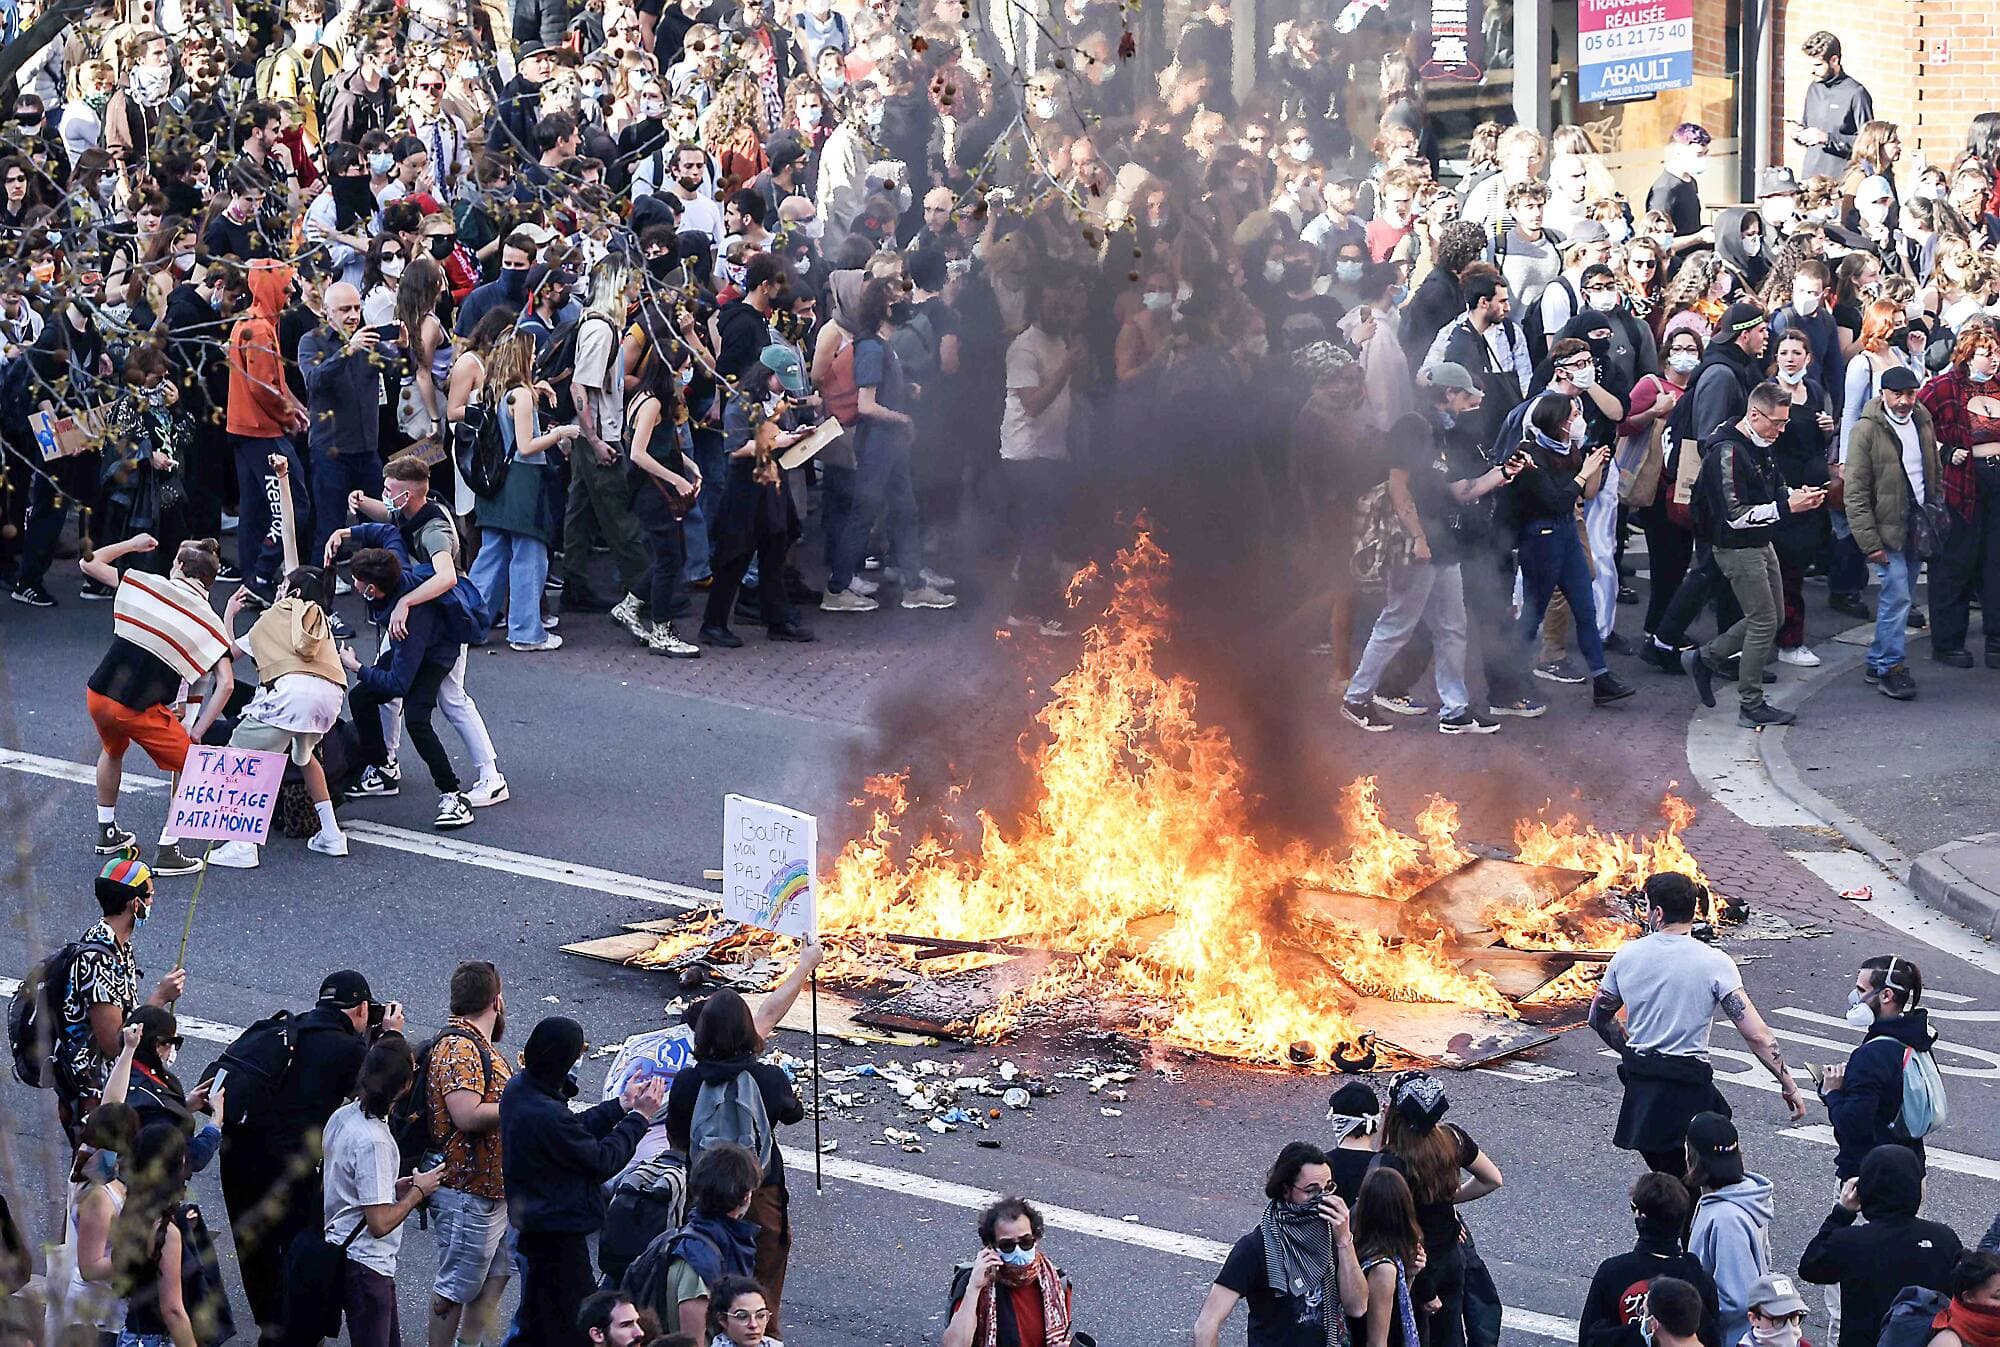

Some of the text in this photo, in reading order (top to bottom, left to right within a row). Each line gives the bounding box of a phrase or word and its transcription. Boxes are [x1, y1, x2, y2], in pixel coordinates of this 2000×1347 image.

[1605, 6, 1667, 29] RÉALISÉE
[1585, 24, 1686, 51] 05 61 21 75 40
[1600, 58, 1673, 88] ABAULT
[1591, 85, 1633, 98] IMMOBILIER
[199, 751, 263, 777] TAXE
[741, 816, 797, 845] BOUFFE
[733, 842, 792, 868] MON CUL
[734, 862, 761, 879] PAS
